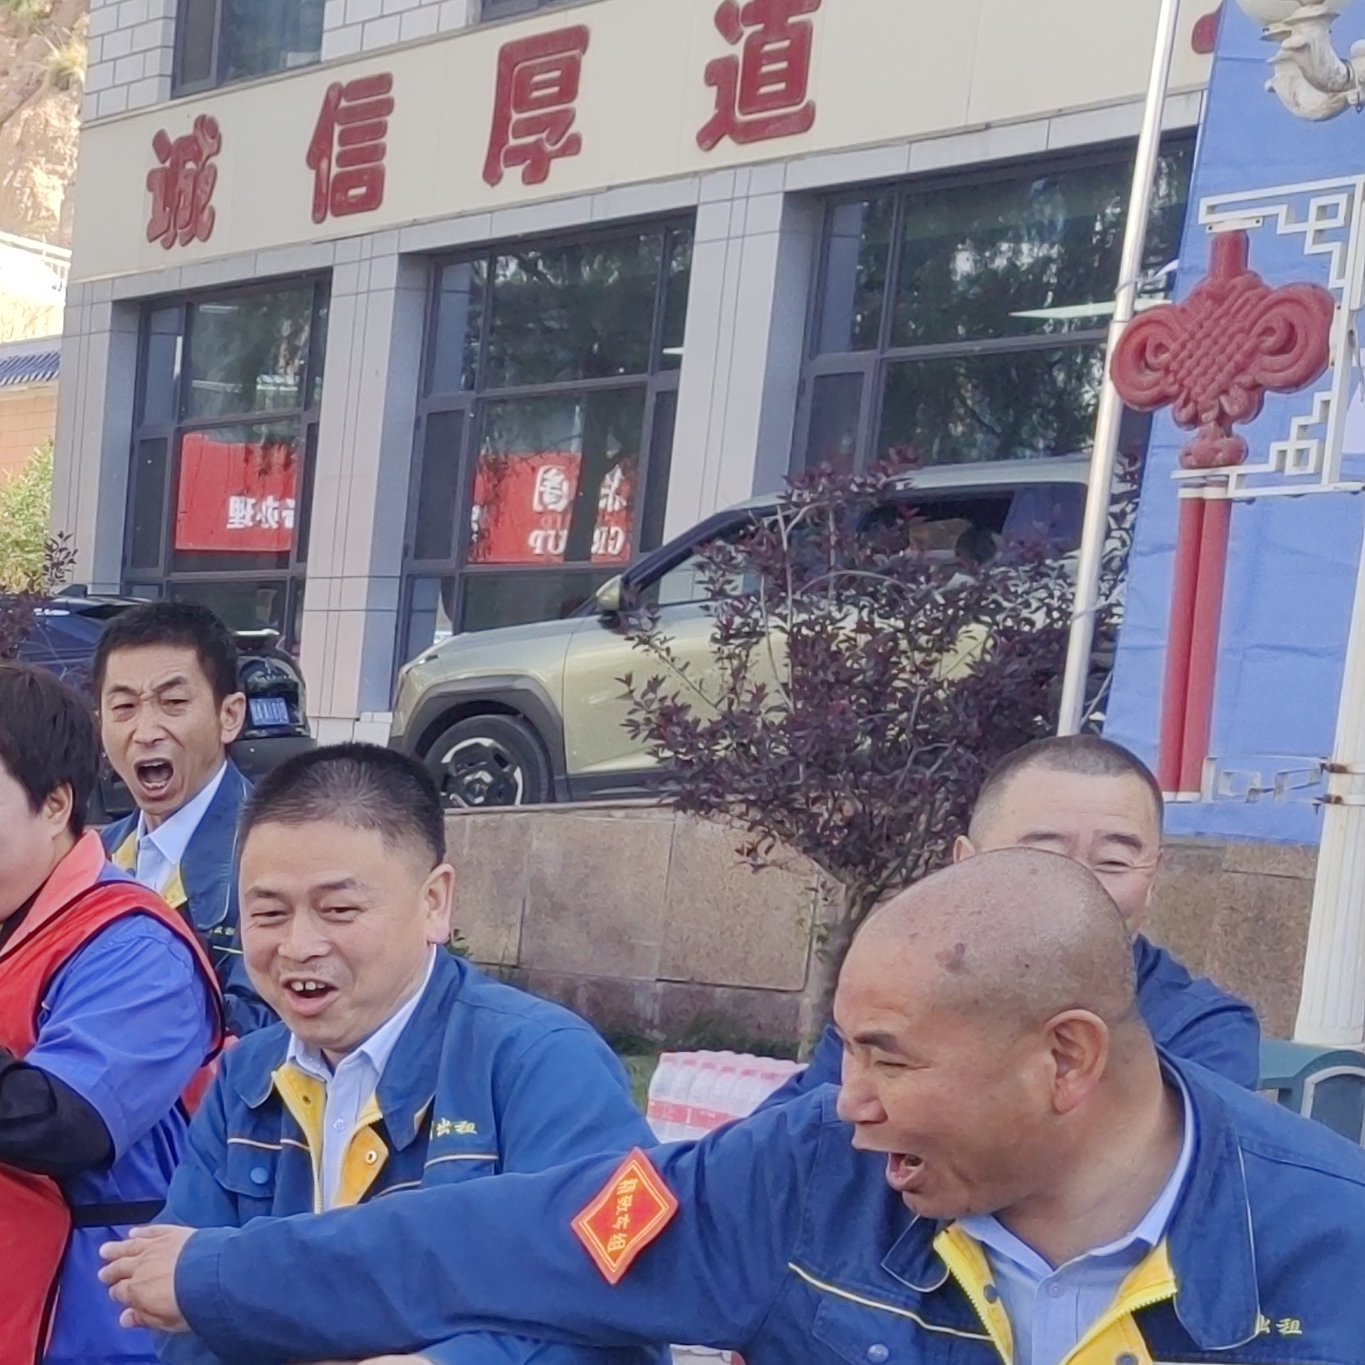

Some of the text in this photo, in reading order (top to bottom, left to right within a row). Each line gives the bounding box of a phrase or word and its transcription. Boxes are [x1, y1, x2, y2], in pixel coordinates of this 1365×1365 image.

[145, 0, 822, 251] 诚信厚道
[430, 1117, 478, 1140] 出租
